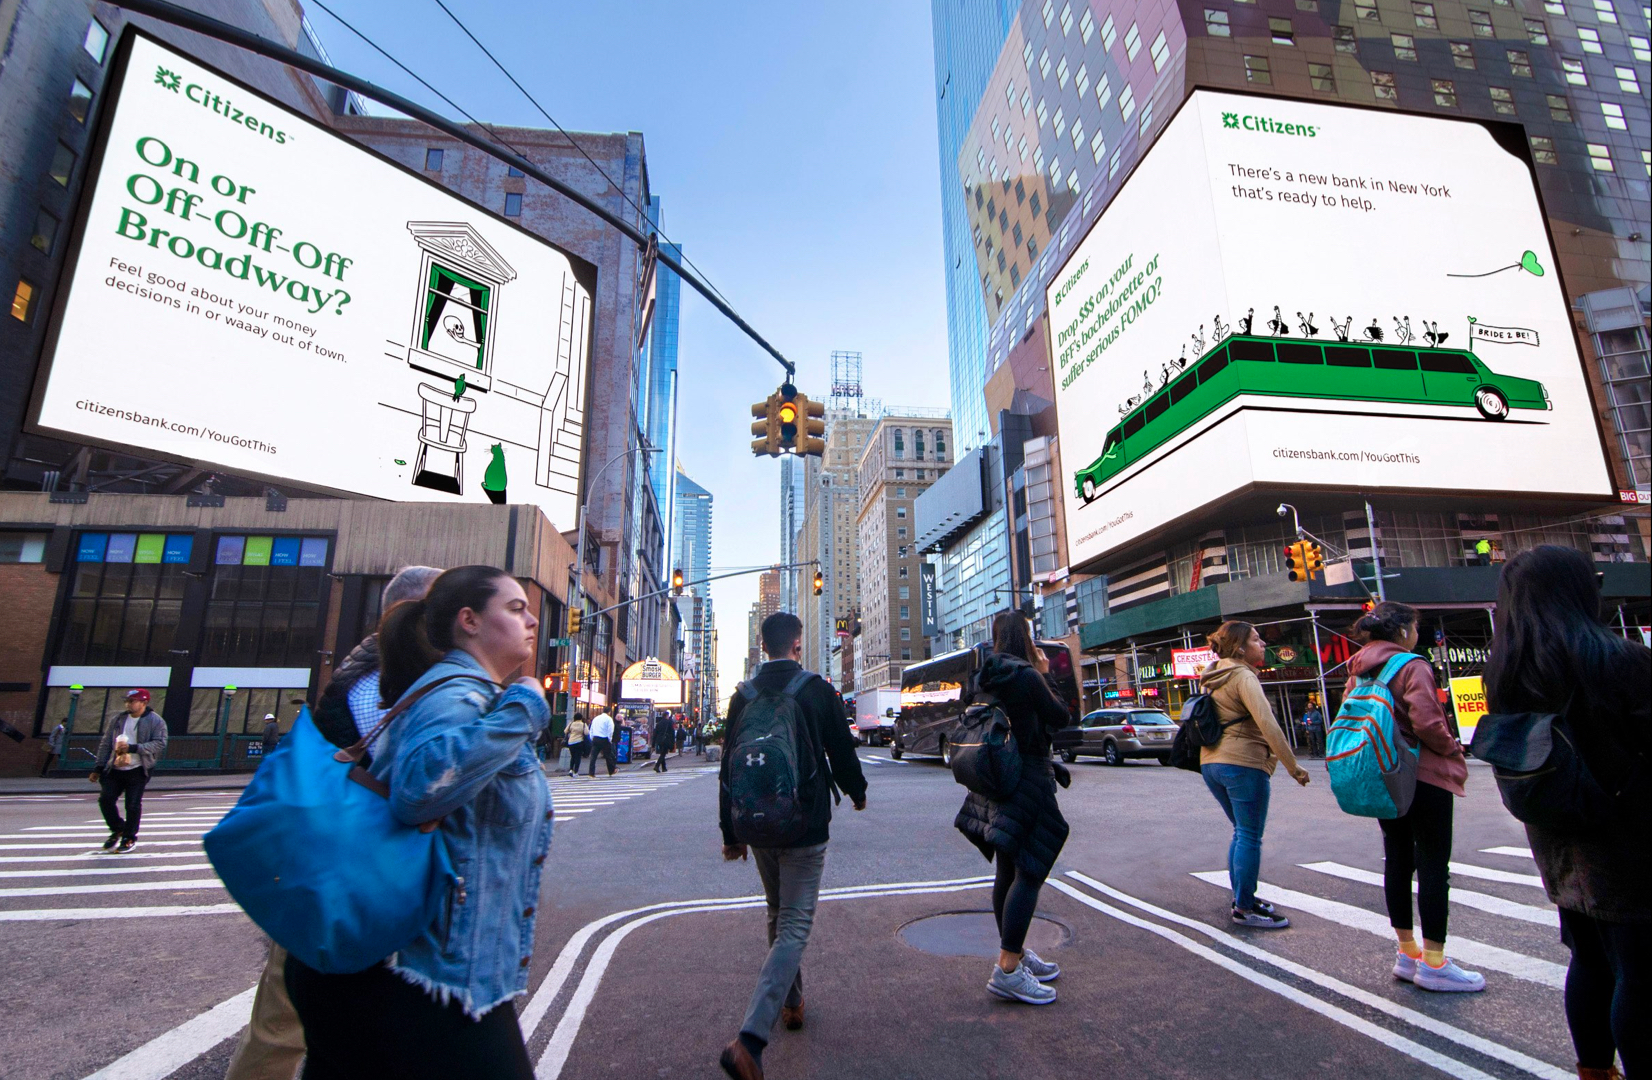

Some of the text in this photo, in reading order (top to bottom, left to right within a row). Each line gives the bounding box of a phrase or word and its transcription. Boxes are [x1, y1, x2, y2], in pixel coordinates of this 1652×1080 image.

[185, 83, 286, 145] Citizens
[1242, 114, 1317, 138] Citizens
[135, 136, 257, 205] On or
[1227, 163, 1452, 198] There's a new bank in New York
[1231, 184, 1377, 213] that's ready to help.
[125, 173, 354, 282] Off-Off-Off
[115, 206, 352, 316] Broadway?
[1061, 258, 1089, 298] Citizens
[105, 275, 347, 363] decisions in or waaay out of town.
[109, 257, 317, 338] Feel good about your money
[1057, 253, 1133, 348] Drop $$$ on your
[1060, 253, 1159, 370] BFF's bachelorette or
[1061, 276, 1162, 391] suffer serious FOMO?
[1478, 328, 1504, 339] BRIDE
[1515, 331, 1530, 340] BE!
[75, 400, 277, 454] citizensbank.com/YouGotThis
[1272, 447, 1421, 464] citizensbank.com/YouGotThis
[1620, 491, 1637, 501] BIG
[922, 573, 935, 626] WESTIN
[1456, 692, 1485, 702] YOUR
